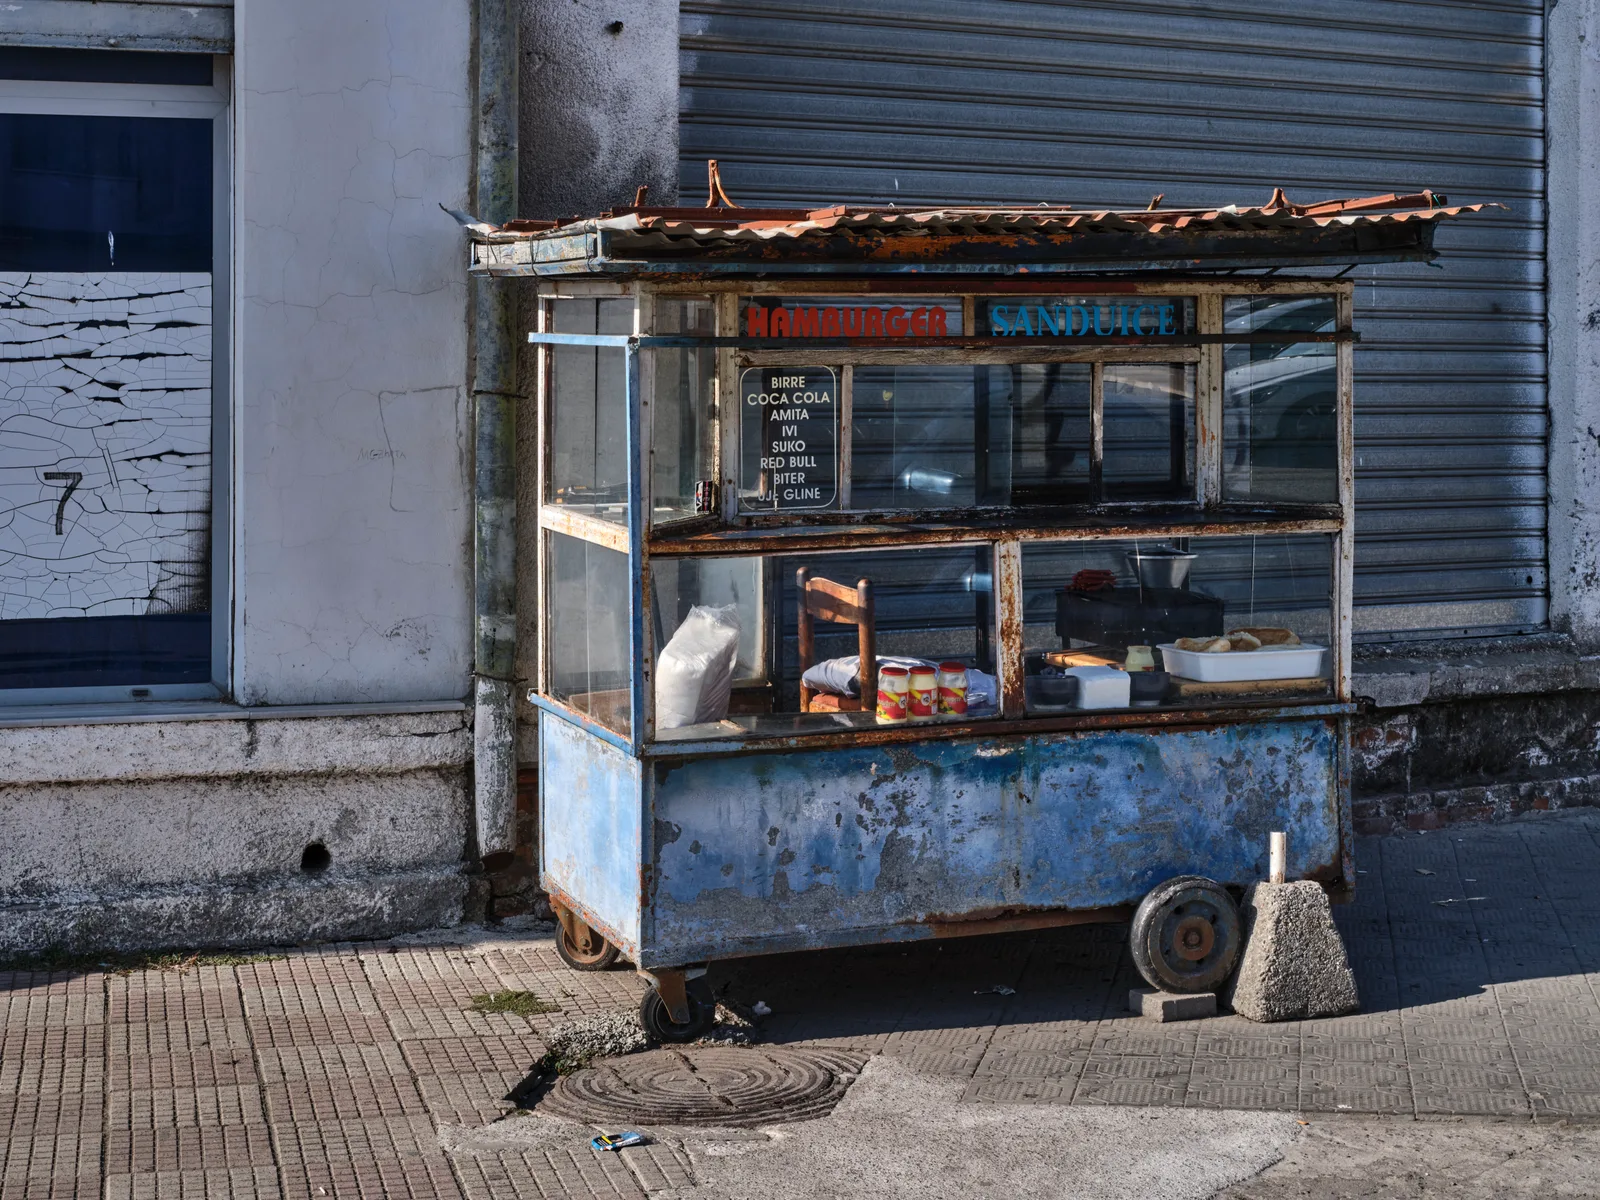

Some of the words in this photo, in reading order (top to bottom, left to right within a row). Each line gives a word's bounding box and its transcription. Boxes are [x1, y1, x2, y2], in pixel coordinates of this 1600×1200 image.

[748, 306, 947, 337] HAMBURGER
[991, 304, 1176, 336] SANDUICE
[771, 376, 806, 389] BIRRE
[747, 393, 789, 406] COCA
[792, 391, 831, 404] COLA
[770, 408, 810, 421] AMITA
[782, 425, 798, 437] IVI
[772, 440, 806, 453] SUKO
[760, 457, 786, 469] RED
[789, 456, 817, 468] BULL
[773, 472, 806, 485] BITER
[783, 488, 821, 500] GLINE
[43, 472, 83, 536] 7
